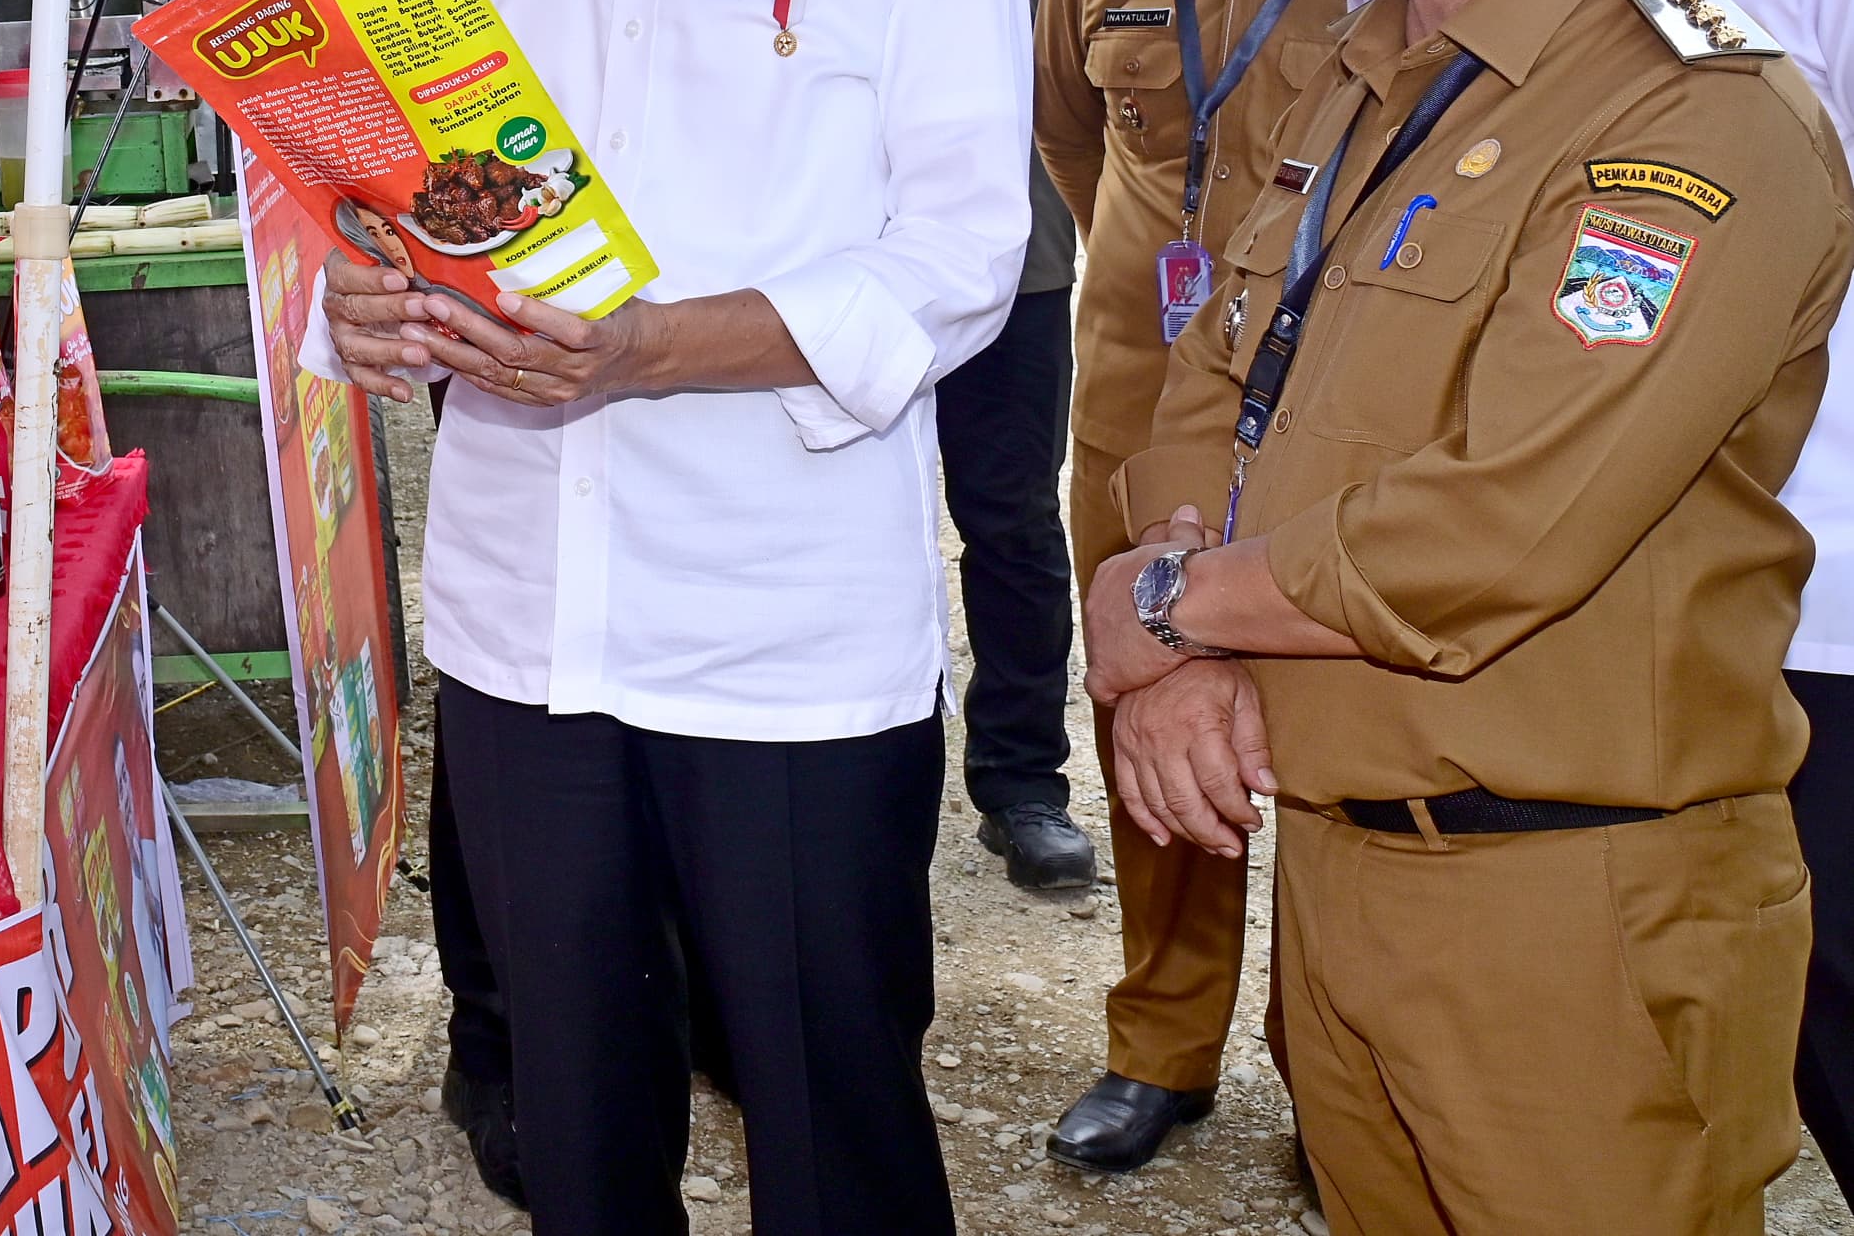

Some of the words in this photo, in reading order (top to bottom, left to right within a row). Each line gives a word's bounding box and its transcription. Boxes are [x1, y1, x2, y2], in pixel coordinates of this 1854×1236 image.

[357, 5, 387, 20] Daging
[362, 16, 387, 28] Jawa,
[366, 20, 401, 36] Bawang
[411, 6, 441, 20] Merah,
[1106, 12, 1166, 23] INAYATULLAH
[209, 16, 255, 48] RENDANG
[215, 11, 315, 69] UJUK
[371, 28, 412, 45] Lengkuas,
[414, 14, 444, 30] Kunyit,
[376, 36, 412, 53] Rendang
[418, 23, 446, 38] Bubuk,
[453, 6, 485, 23] Santan,
[408, 49, 430, 61] Daun
[432, 36, 463, 52] Kunyit,
[465, 20, 495, 37] Garam
[381, 51, 401, 61] Cabe
[404, 40, 431, 53] Giling,
[433, 28, 454, 42] Serai
[414, 56, 443, 70] Merah.
[266, 85, 298, 98] Makanan
[301, 79, 320, 88] Khas
[323, 75, 337, 84] dari
[343, 67, 370, 78] Daerah
[310, 84, 339, 95] Provinsi
[341, 76, 375, 87] Sumatera
[416, 73, 471, 100] DIPRODUKSI
[471, 59, 496, 76] OLEH
[293, 98, 320, 109] Terbuat
[337, 88, 360, 98] Bahan
[362, 83, 380, 93] Baku
[338, 95, 372, 107] Makanan
[429, 112, 454, 126] Musi
[454, 98, 488, 117] Rawas
[489, 81, 520, 99] Utara,
[443, 89, 480, 111] DAPUR
[482, 82, 493, 93] EF
[312, 115, 331, 125] yang
[350, 112, 384, 123] Makanan
[437, 111, 483, 134] Sumatera
[486, 89, 522, 112] Selatan
[339, 126, 357, 136] Oleh
[365, 119, 383, 130] Oleh
[342, 131, 381, 146] Penasaran
[385, 124, 405, 134] Akan
[503, 124, 538, 149] Lemak
[344, 143, 370, 154] Segera
[378, 132, 409, 145] Hubungi
[513, 136, 538, 155] Nian
[363, 158, 386, 168] Galeri
[391, 149, 418, 161] DAPUR
[1596, 168, 1646, 182] PEMKAB
[1649, 170, 1683, 190] MURA
[1686, 182, 1723, 210] UTARA
[505, 249, 527, 263] KODE
[527, 227, 565, 253] PRODUKSI
[1590, 214, 1614, 232] MUSI
[1615, 221, 1648, 242] RAWAS
[1649, 232, 1680, 254] UTARA
[532, 275, 578, 299] DIGUNAKAN
[578, 254, 609, 277] SEBELUM
